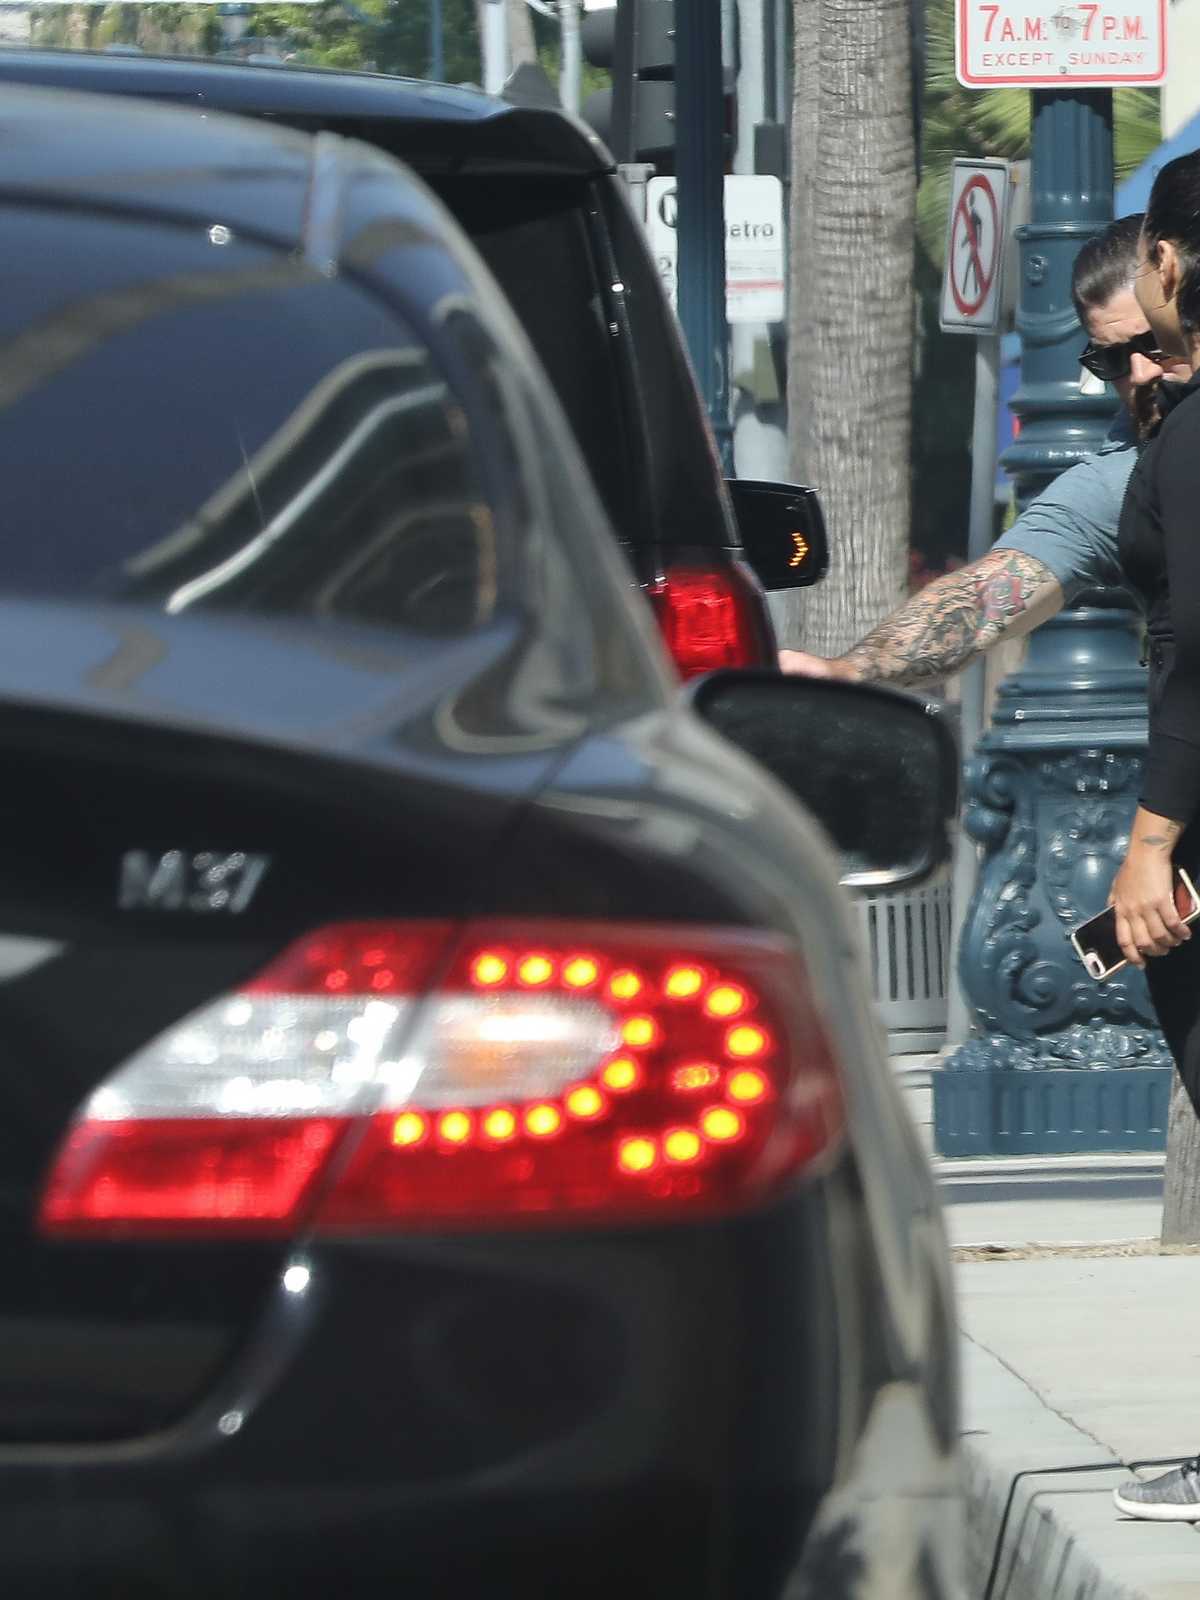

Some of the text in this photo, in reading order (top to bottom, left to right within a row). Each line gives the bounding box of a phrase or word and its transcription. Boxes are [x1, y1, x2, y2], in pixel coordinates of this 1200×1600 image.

[983, 52, 1147, 66] EXCEPT SUNDAY
[729, 220, 774, 238] etro
[118, 850, 270, 912] M37
